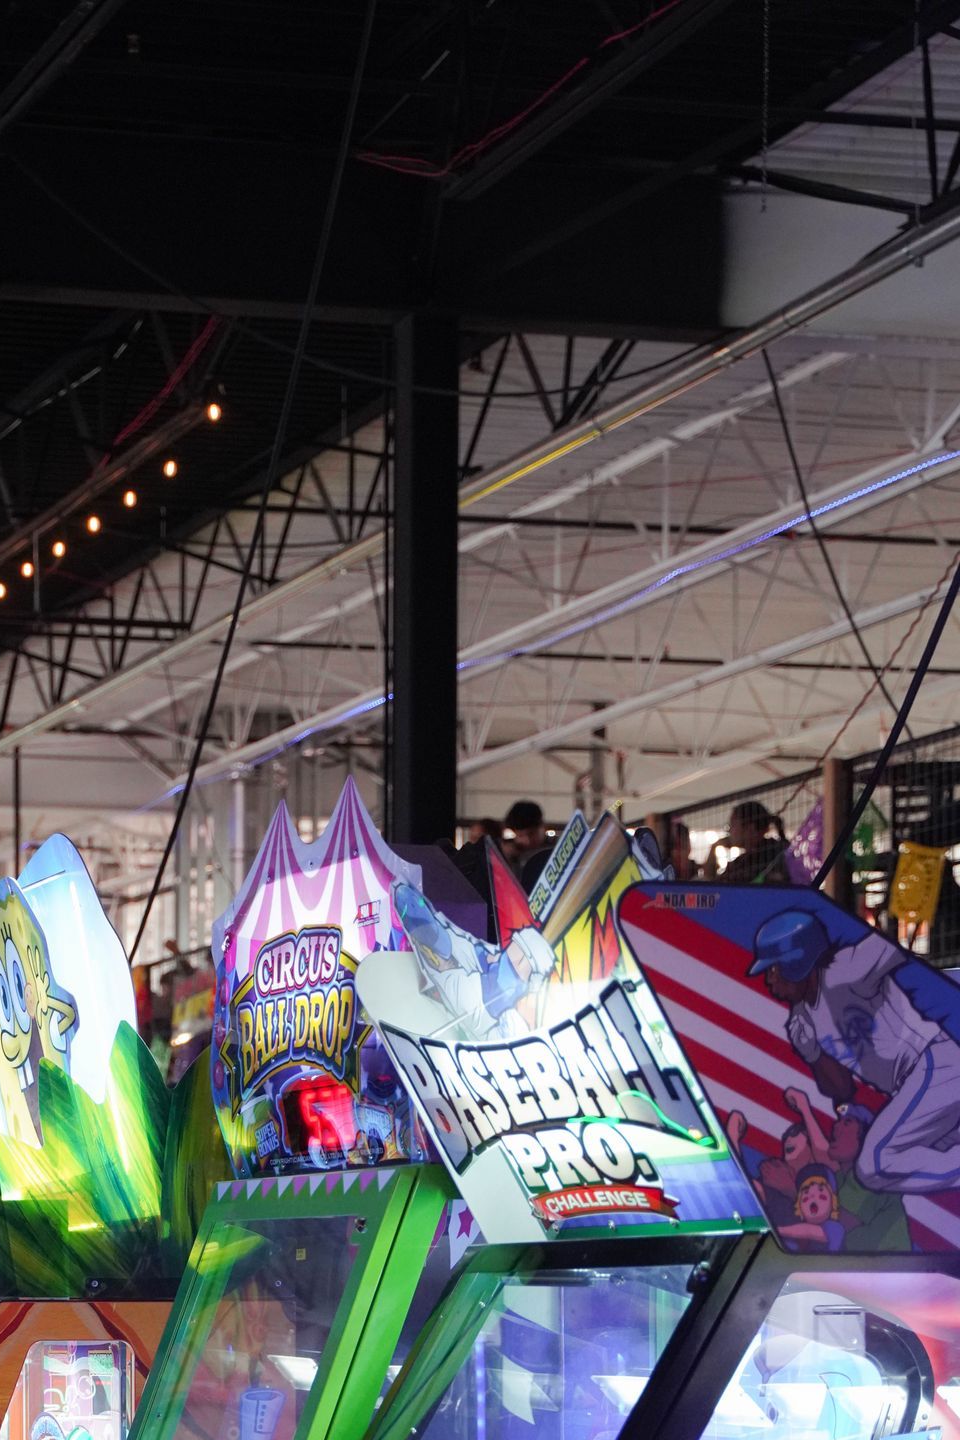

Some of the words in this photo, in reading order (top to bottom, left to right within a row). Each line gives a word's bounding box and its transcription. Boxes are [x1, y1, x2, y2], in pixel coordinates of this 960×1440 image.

[529, 884, 551, 919] REAL
[653, 892, 717, 910] ANDAMIRO
[256, 934, 340, 996] CIRCUS
[239, 998, 292, 1080] BALL
[294, 985, 355, 1067] DROP
[380, 978, 719, 1176] BASEBALL
[254, 1122, 277, 1143] SUPER
[257, 1135, 280, 1158] BONUS
[501, 1121, 658, 1192] PRO.
[544, 1190, 651, 1215] CHALLENGE
